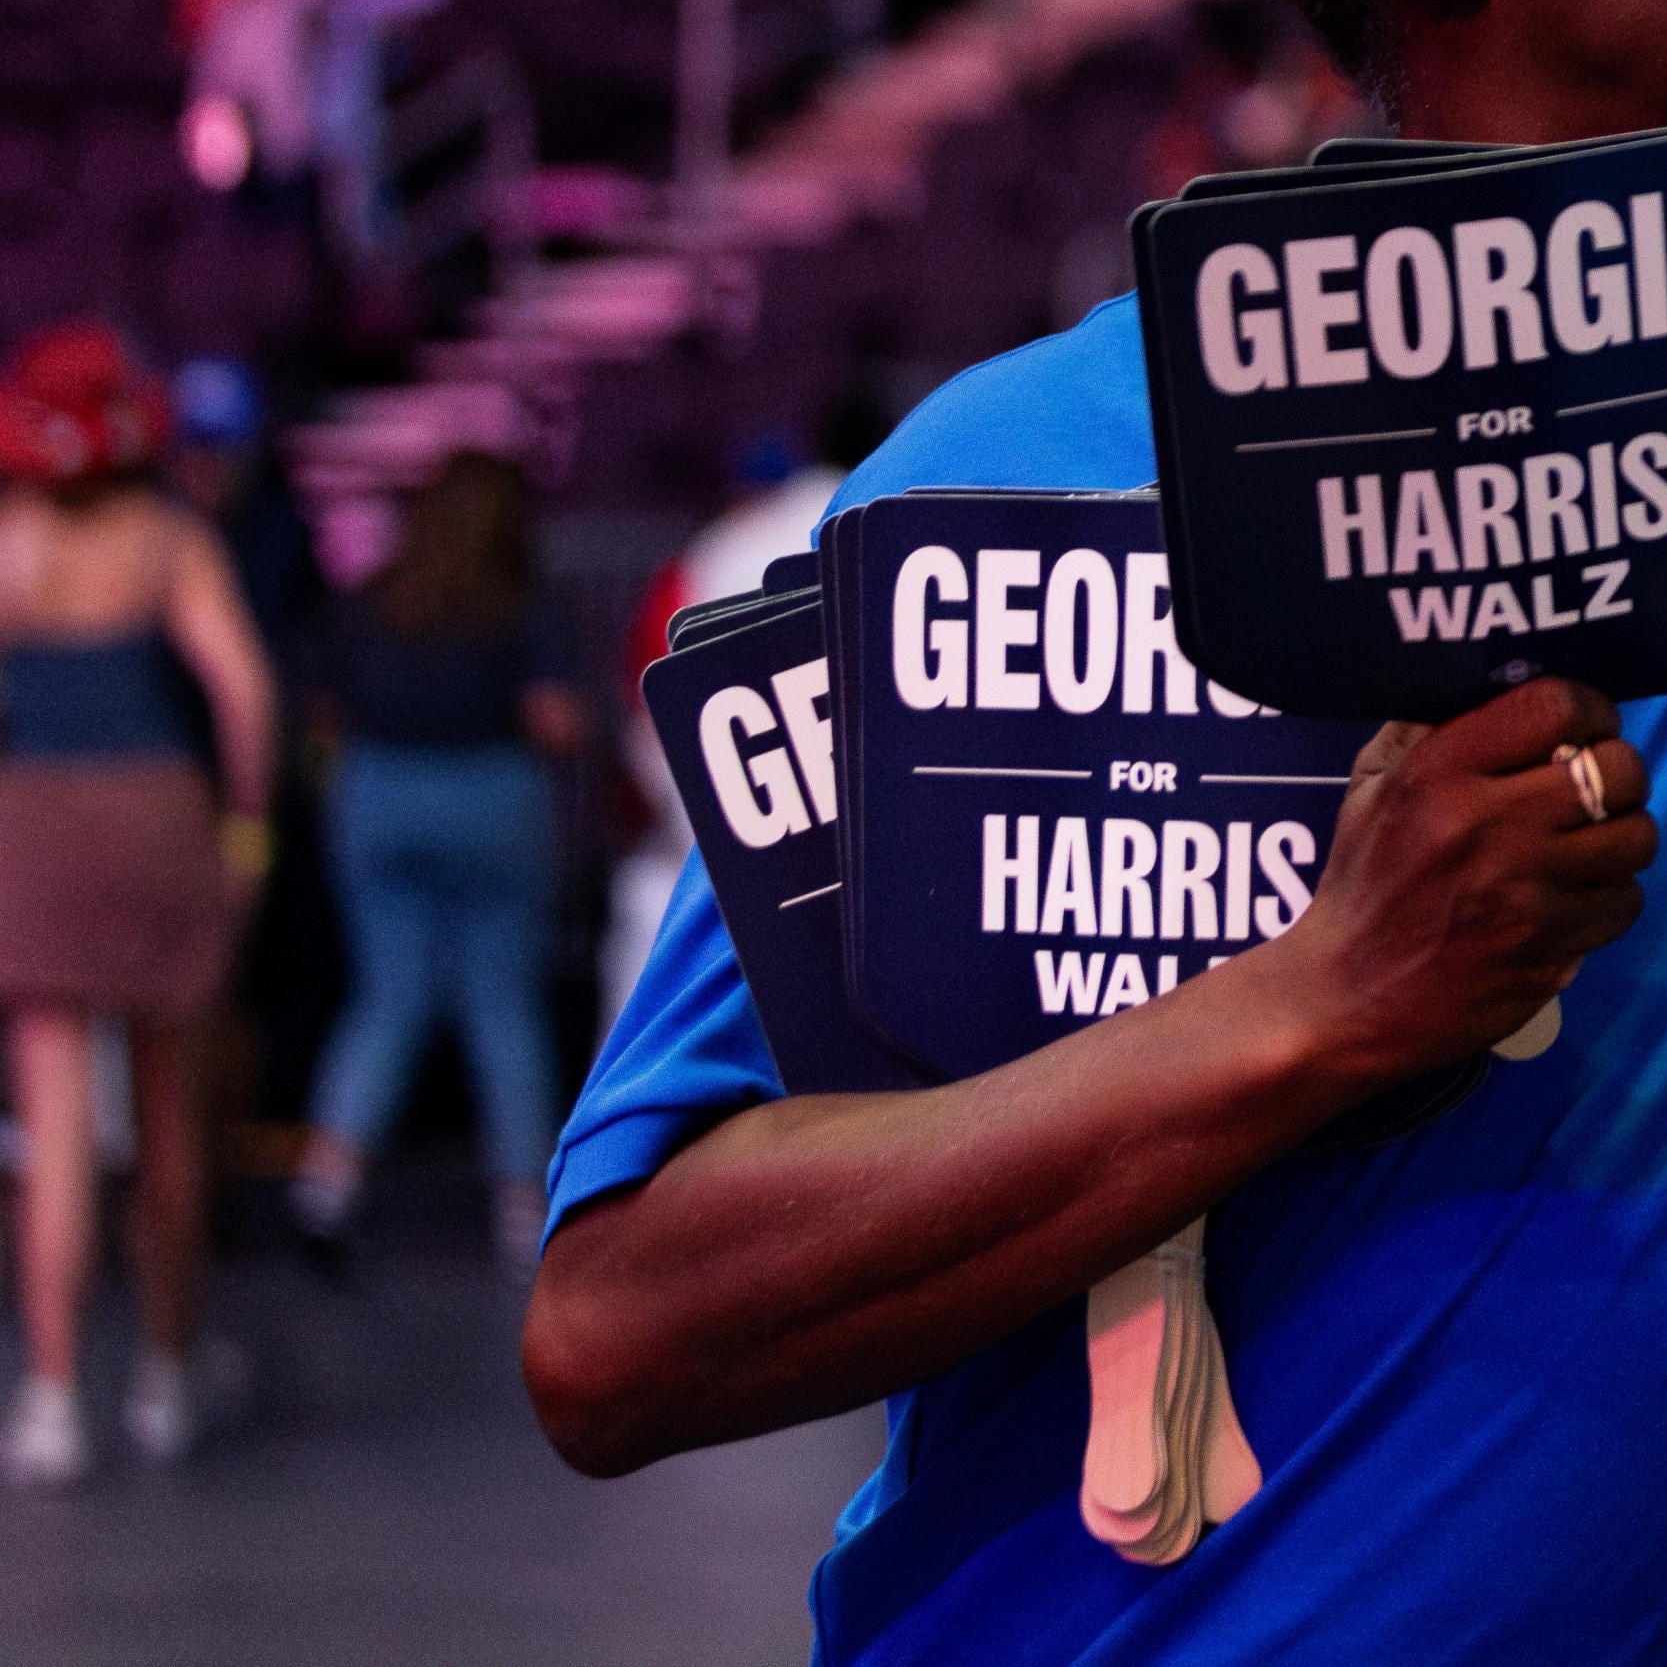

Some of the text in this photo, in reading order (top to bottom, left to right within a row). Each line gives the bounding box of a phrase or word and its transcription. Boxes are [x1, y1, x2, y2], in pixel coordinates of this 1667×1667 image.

[1457, 406, 1533, 443] FOR
[891, 544, 1284, 719] GEOR
[1388, 559, 1632, 644] WALZ
[1108, 760, 1178, 793] FOR
[980, 812, 1318, 942] HARRIS
[1033, 949, 1235, 1017] WAL
